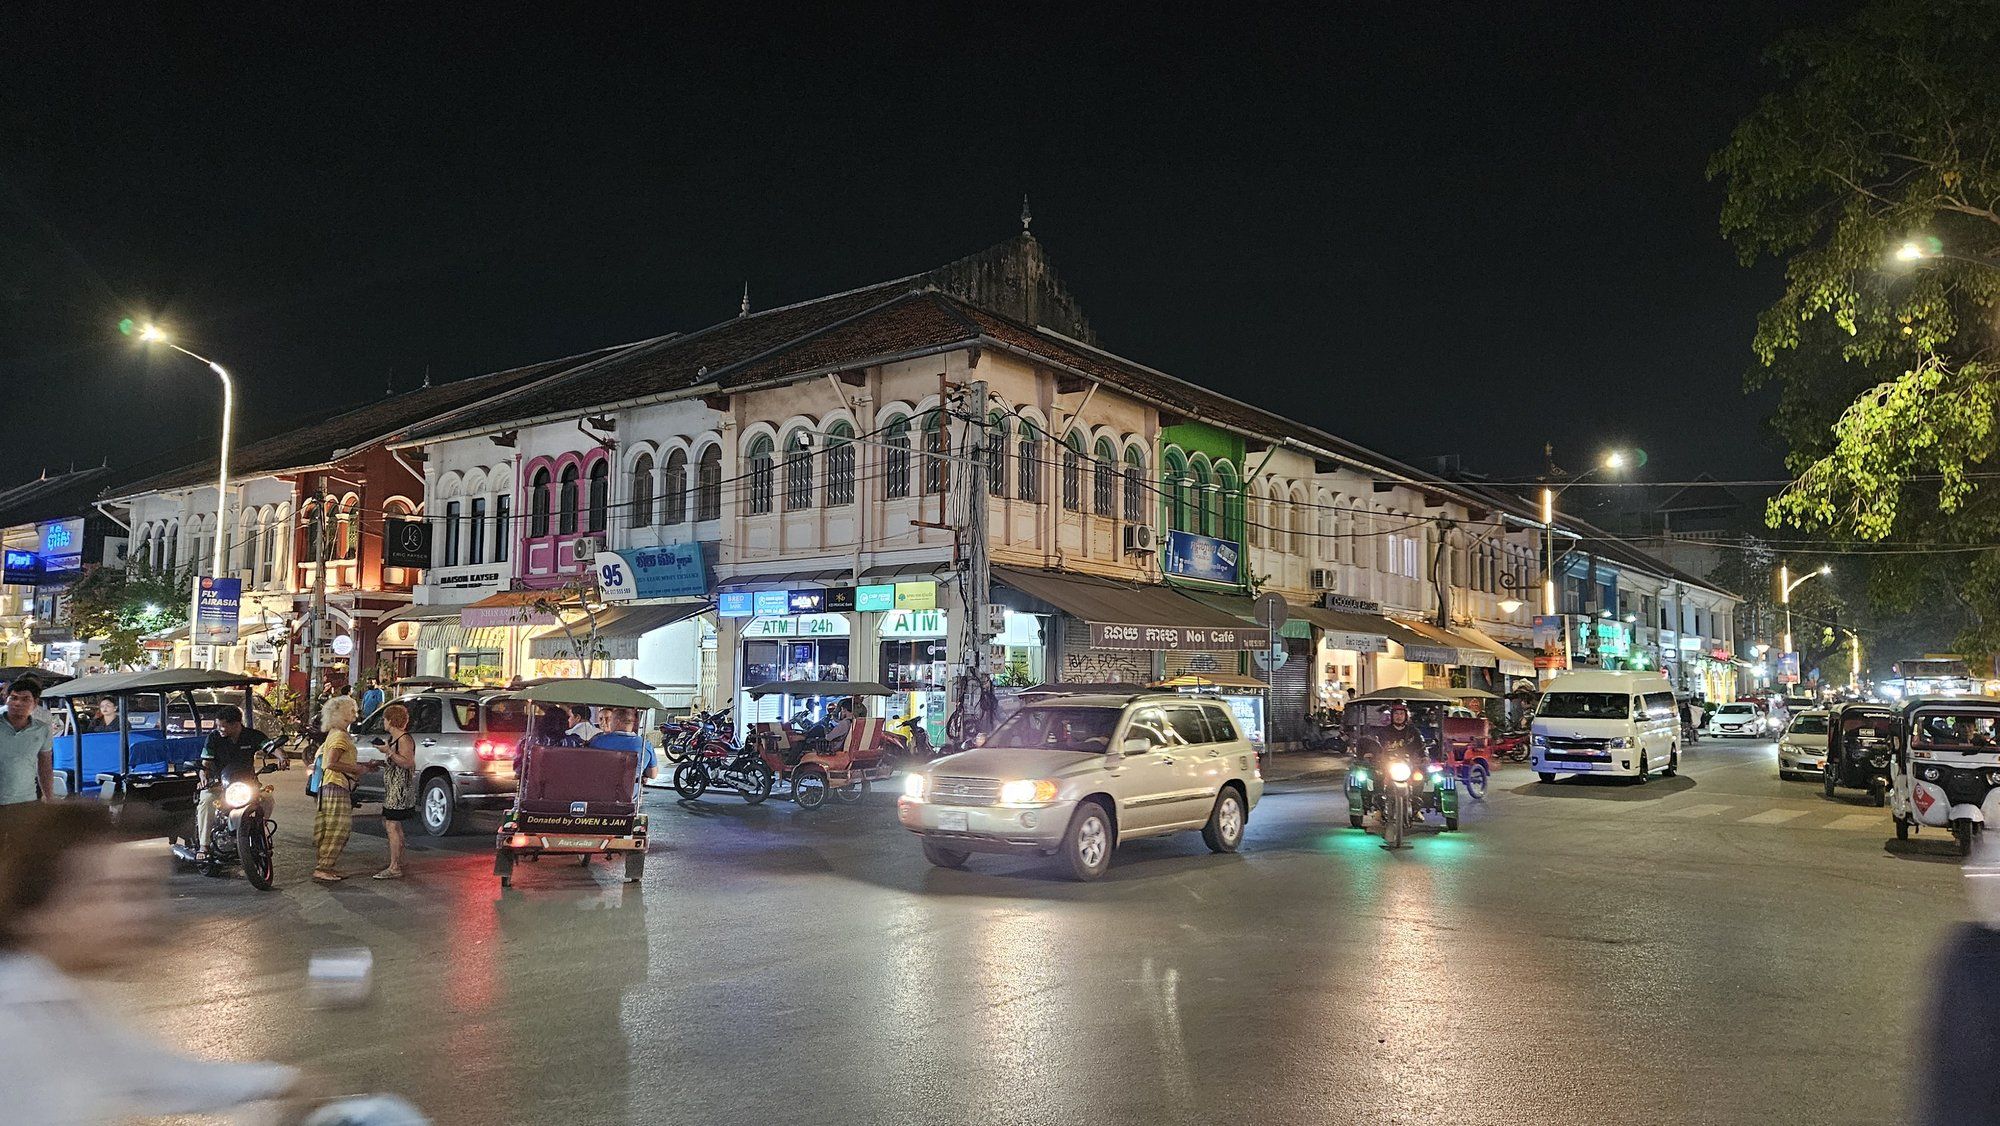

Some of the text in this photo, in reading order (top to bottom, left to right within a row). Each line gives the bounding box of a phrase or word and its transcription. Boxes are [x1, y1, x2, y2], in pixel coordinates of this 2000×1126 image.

[470, 573, 499, 582] KAYSER
[602, 564, 623, 587] 95
[201, 590, 218, 598] FLY
[201, 598, 238, 607] AIRASIA
[762, 620, 788, 634] ATM
[811, 619, 833, 633] 24h
[895, 611, 938, 632] ATM
[1186, 630, 1235, 643] Noi Café
[527, 815, 627, 826] Donated by OWEN & JAN
